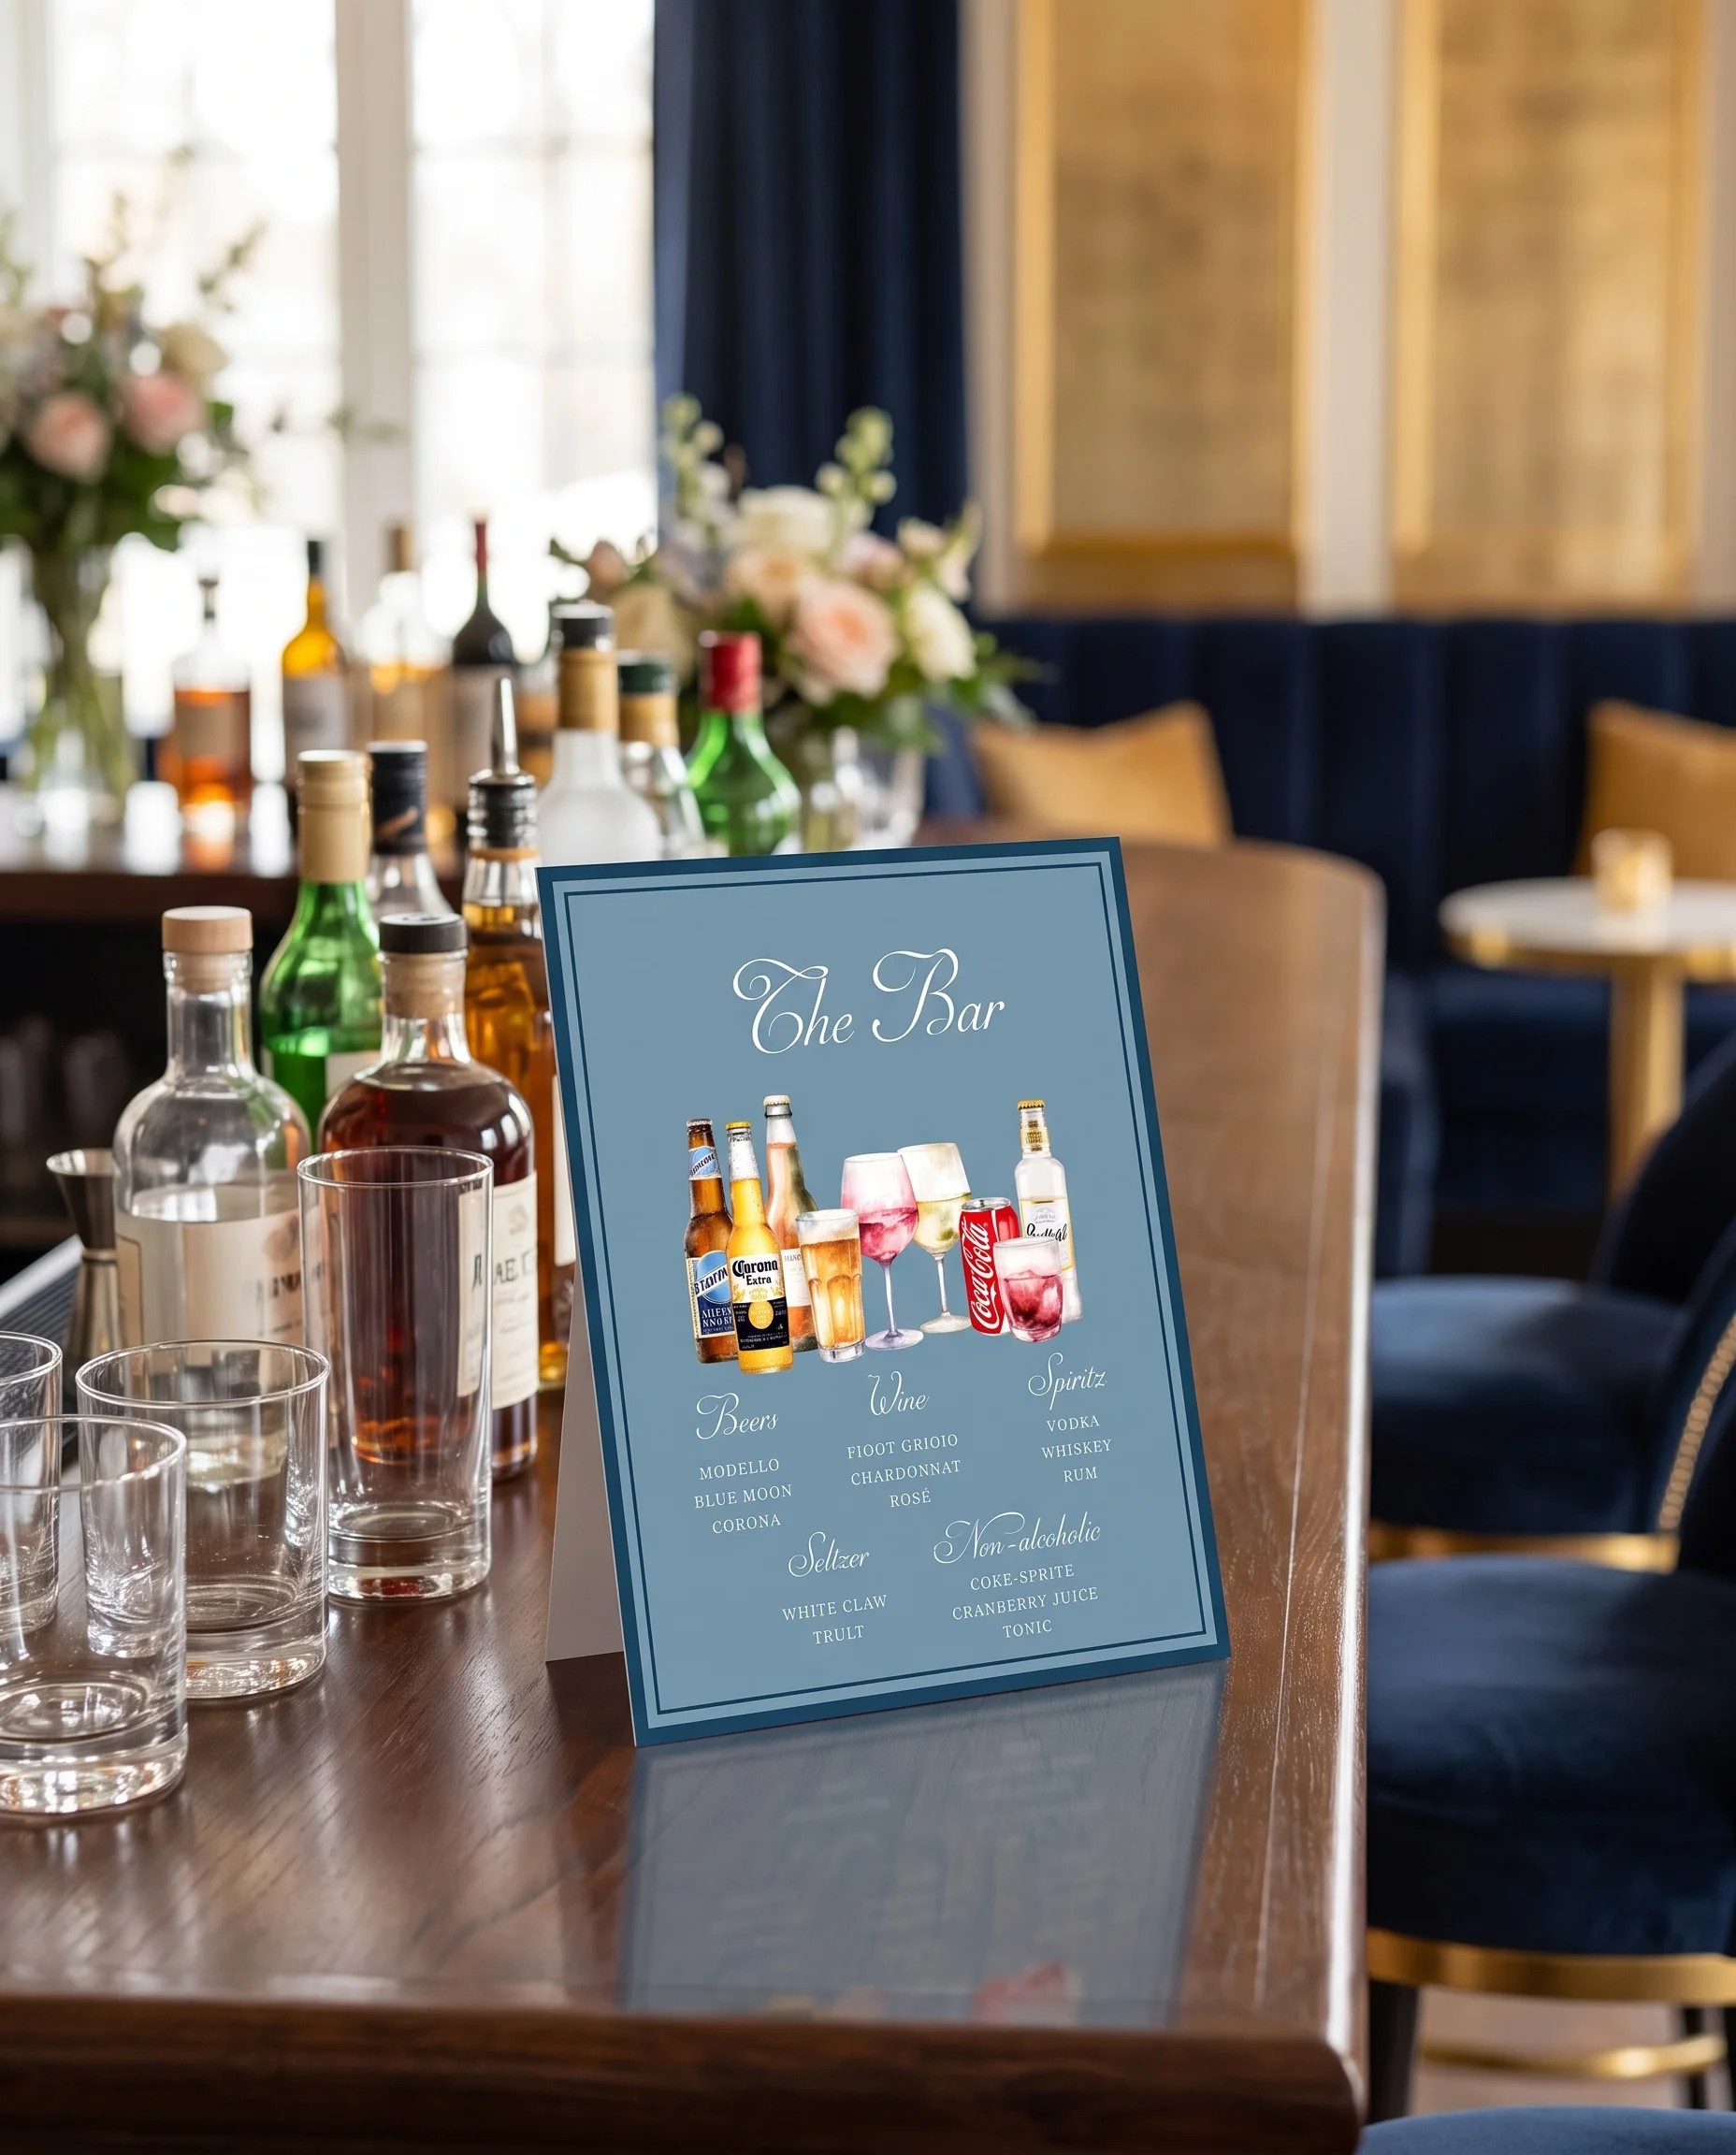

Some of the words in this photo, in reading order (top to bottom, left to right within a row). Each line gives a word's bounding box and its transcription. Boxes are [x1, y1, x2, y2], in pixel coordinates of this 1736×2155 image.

[733, 958, 855, 1054] The
[872, 947, 1005, 1043] Bar
[732, 1260, 778, 1279] Corona
[746, 1275, 772, 1286] Extra
[867, 1370, 929, 1416] Wine
[1027, 1352, 1107, 1410] Spiritz
[696, 1392, 779, 1440] Beers
[1046, 1414, 1100, 1432] VODKA
[846, 1441, 895, 1459] FIOOT
[901, 1434, 959, 1453] GRIOIO
[1041, 1439, 1111, 1459] WHISKEY
[699, 1458, 780, 1481] MODELLO
[849, 1458, 962, 1486] CHARDONNAT
[1063, 1466, 1098, 1483] RUM
[694, 1491, 737, 1509] BLUE
[743, 1483, 793, 1503] MOON
[890, 1487, 932, 1508] ROSÉ
[712, 1513, 782, 1534] CORONA
[933, 1511, 1101, 1564] Non-alcoholic
[788, 1531, 870, 1578] Seltzer
[970, 1565, 1075, 1591] COKE-SPRITE
[781, 1601, 838, 1621] WHITE
[842, 1594, 889, 1613] CLAW
[952, 1595, 1048, 1621] CRANBERRY
[1052, 1586, 1098, 1606] JUICE
[812, 1625, 864, 1645] TRULT
[1002, 1619, 1053, 1639] TONIC
